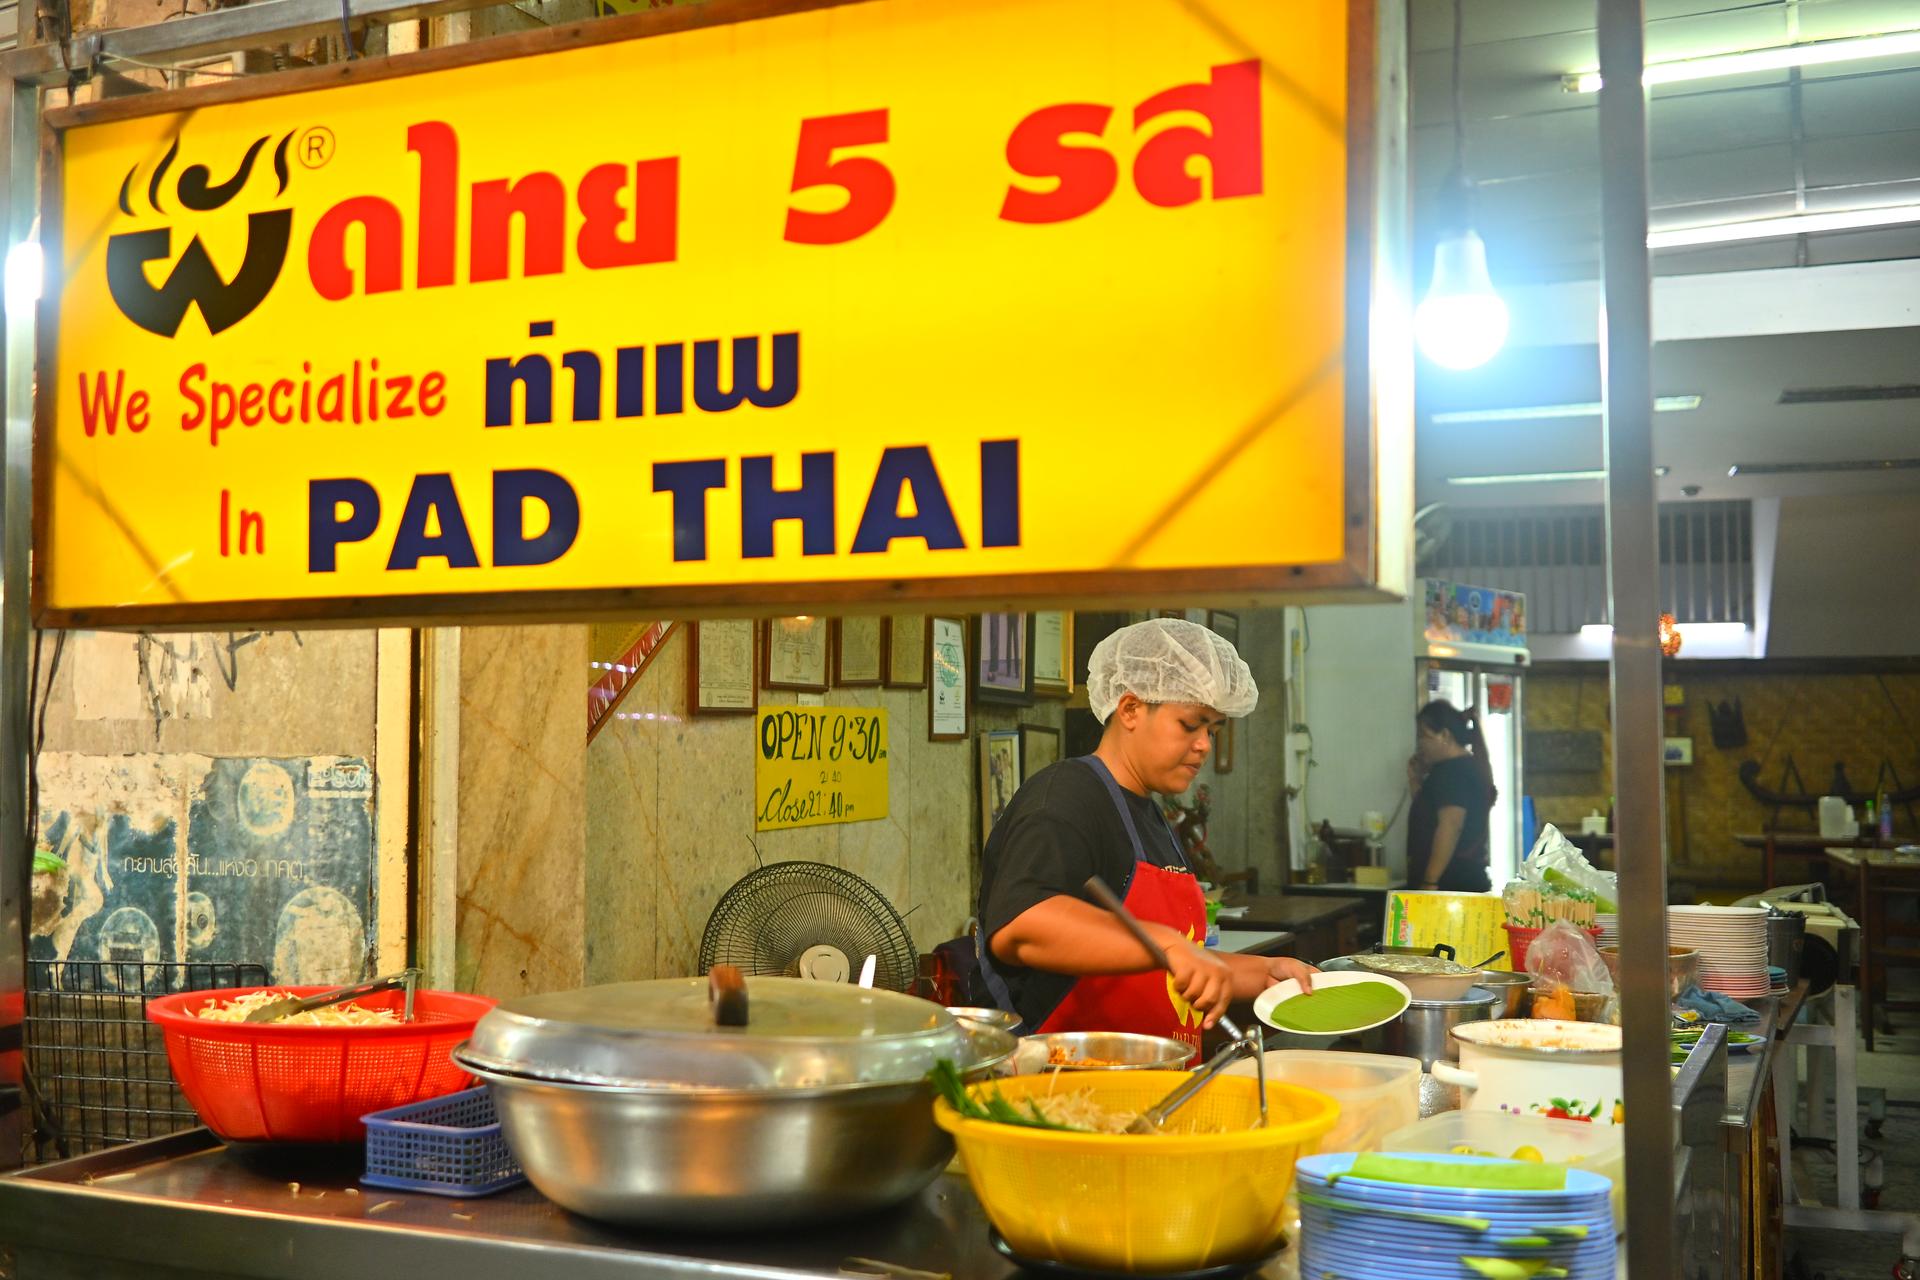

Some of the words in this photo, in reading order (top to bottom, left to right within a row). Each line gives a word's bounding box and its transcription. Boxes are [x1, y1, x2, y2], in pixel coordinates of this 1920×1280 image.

[783, 107, 897, 246] 5
[998, 57, 1263, 224] รส
[79, 369, 150, 437] We
[179, 357, 447, 446] Specialize
[484, 320, 800, 428] ท่าแพ
[220, 489, 265, 556] In
[308, 468, 581, 573] PAD
[652, 438, 1020, 562] THAI
[761, 711, 827, 761] OPEN
[758, 778, 809, 822] Close
